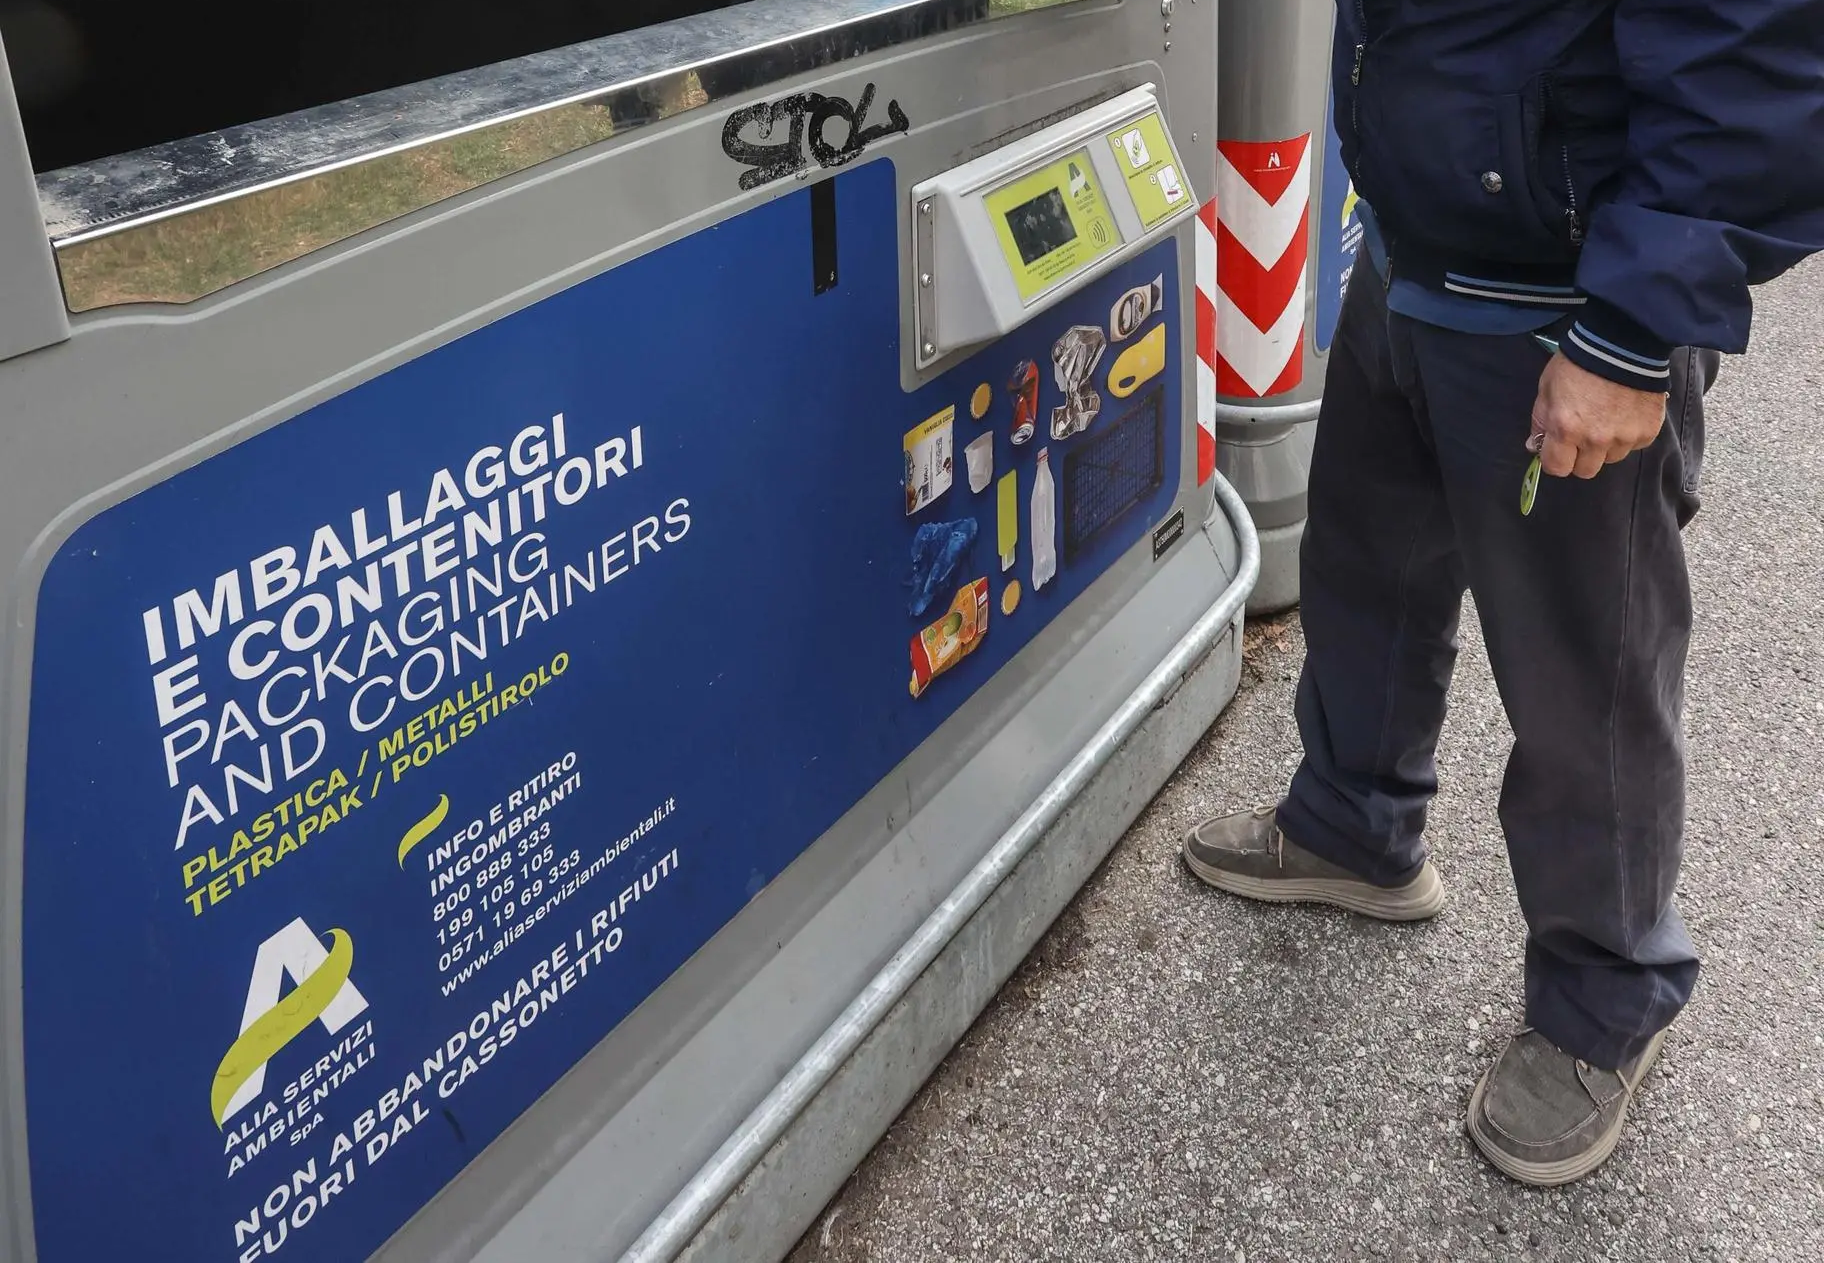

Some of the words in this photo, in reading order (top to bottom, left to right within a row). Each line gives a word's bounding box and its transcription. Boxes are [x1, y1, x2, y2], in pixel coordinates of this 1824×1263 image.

[143, 413, 566, 665] IMBALLAGGI
[153, 654, 206, 727] E
[228, 425, 642, 680] CONTENITORI
[163, 533, 548, 788] PACKAGING
[174, 719, 326, 851] AND
[349, 498, 690, 732] CONTAINERS
[183, 769, 348, 889] PLASTICA
[357, 749, 368, 777] /
[379, 672, 492, 762] METALLI
[185, 785, 363, 916] TETRAPAK
[371, 771, 382, 798] /
[392, 653, 568, 783] POLISTIROLO
[428, 820, 483, 871] INFO
[489, 803, 503, 826] E
[508, 752, 576, 812] RITIRO
[431, 772, 580, 897] INGOMBRANTI
[434, 883, 470, 921] 800
[476, 851, 512, 888] 888
[518, 822, 550, 856] 333
[437, 908, 473, 945] 199
[480, 875, 514, 911] 105
[520, 844, 553, 879] 105
[439, 925, 483, 971] 0571
[493, 901, 515, 927] 19
[521, 879, 543, 906] 69
[549, 850, 580, 884] 333
[441, 797, 675, 996] www.aliaserviziambientali.it
[224, 1101, 278, 1154] ALIA
[283, 1020, 372, 1103] SERVIZI
[228, 1042, 375, 1178] AMBIENTALI
[235, 1157, 316, 1247] NON
[329, 942, 568, 1166] ABBANDONARE
[576, 929, 583, 951] I
[592, 848, 678, 938] RIFIUTI
[366, 1100, 429, 1165] DAL
[439, 927, 623, 1098] CASSONETTO
